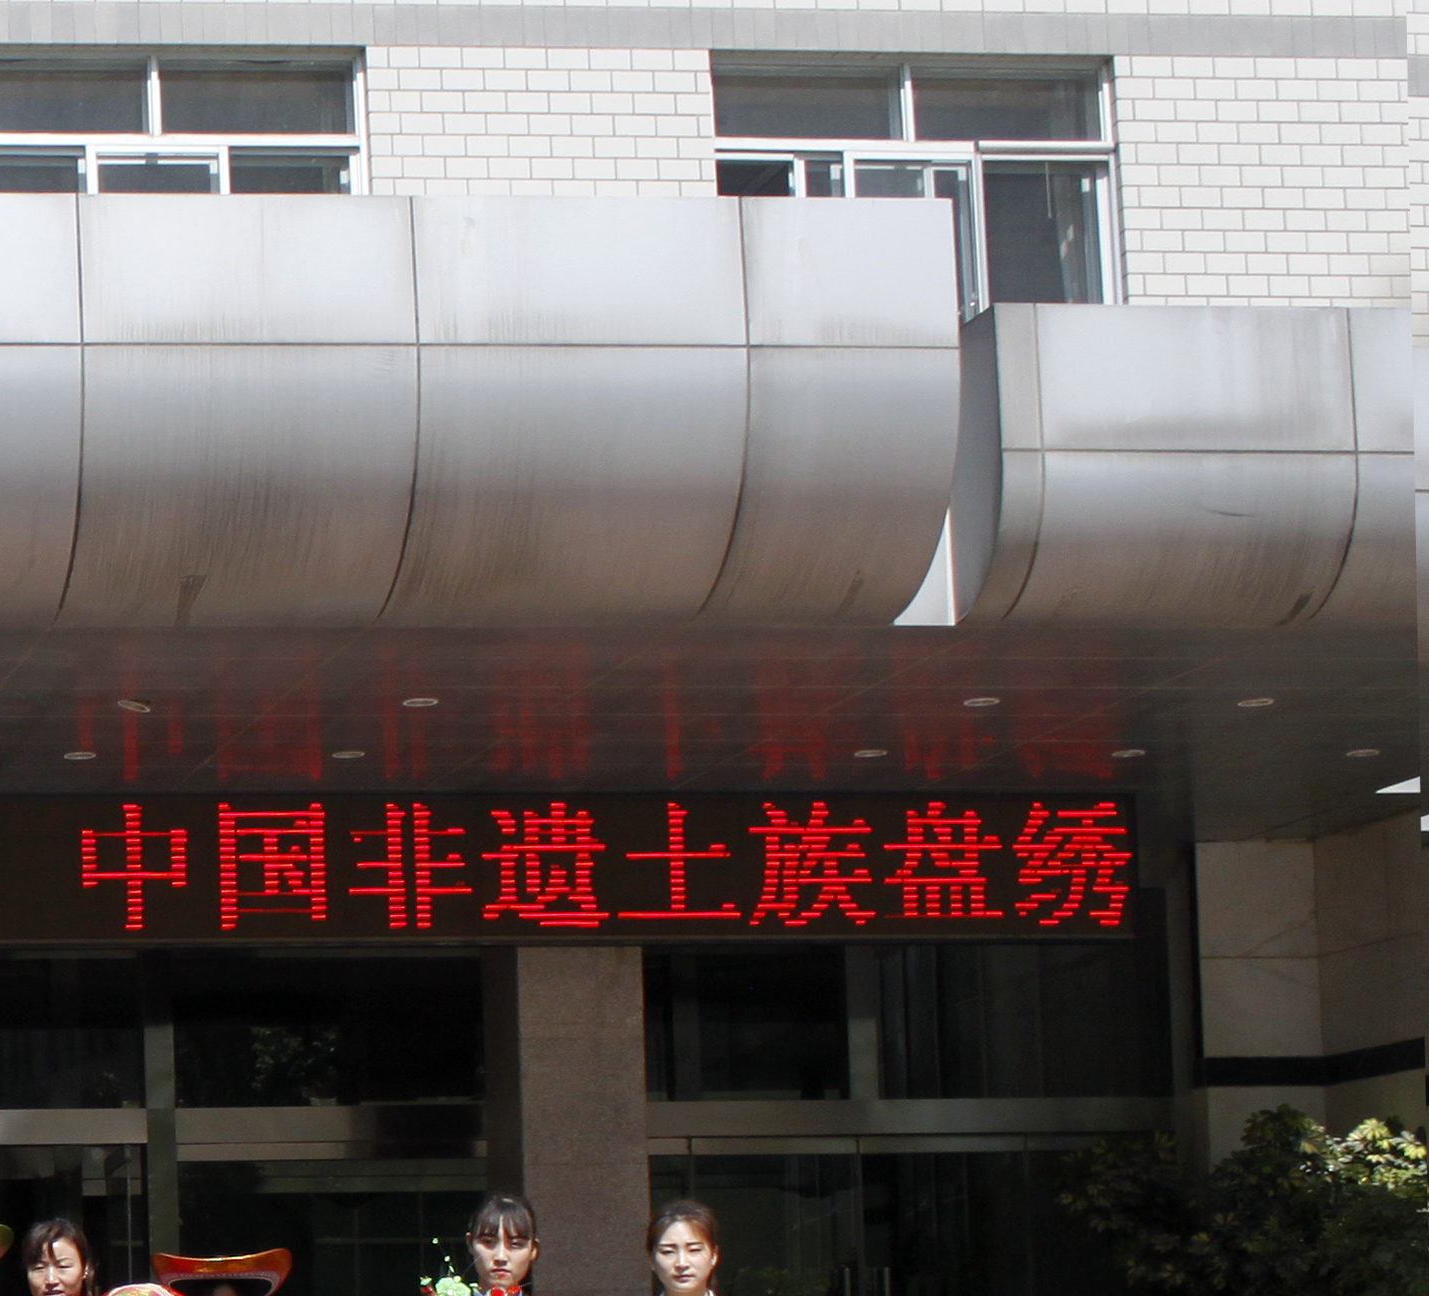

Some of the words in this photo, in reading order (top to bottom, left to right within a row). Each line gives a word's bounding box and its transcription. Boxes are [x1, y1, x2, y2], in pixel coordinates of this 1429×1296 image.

[81, 801, 1133, 930] 中国非遗土族盘绣
